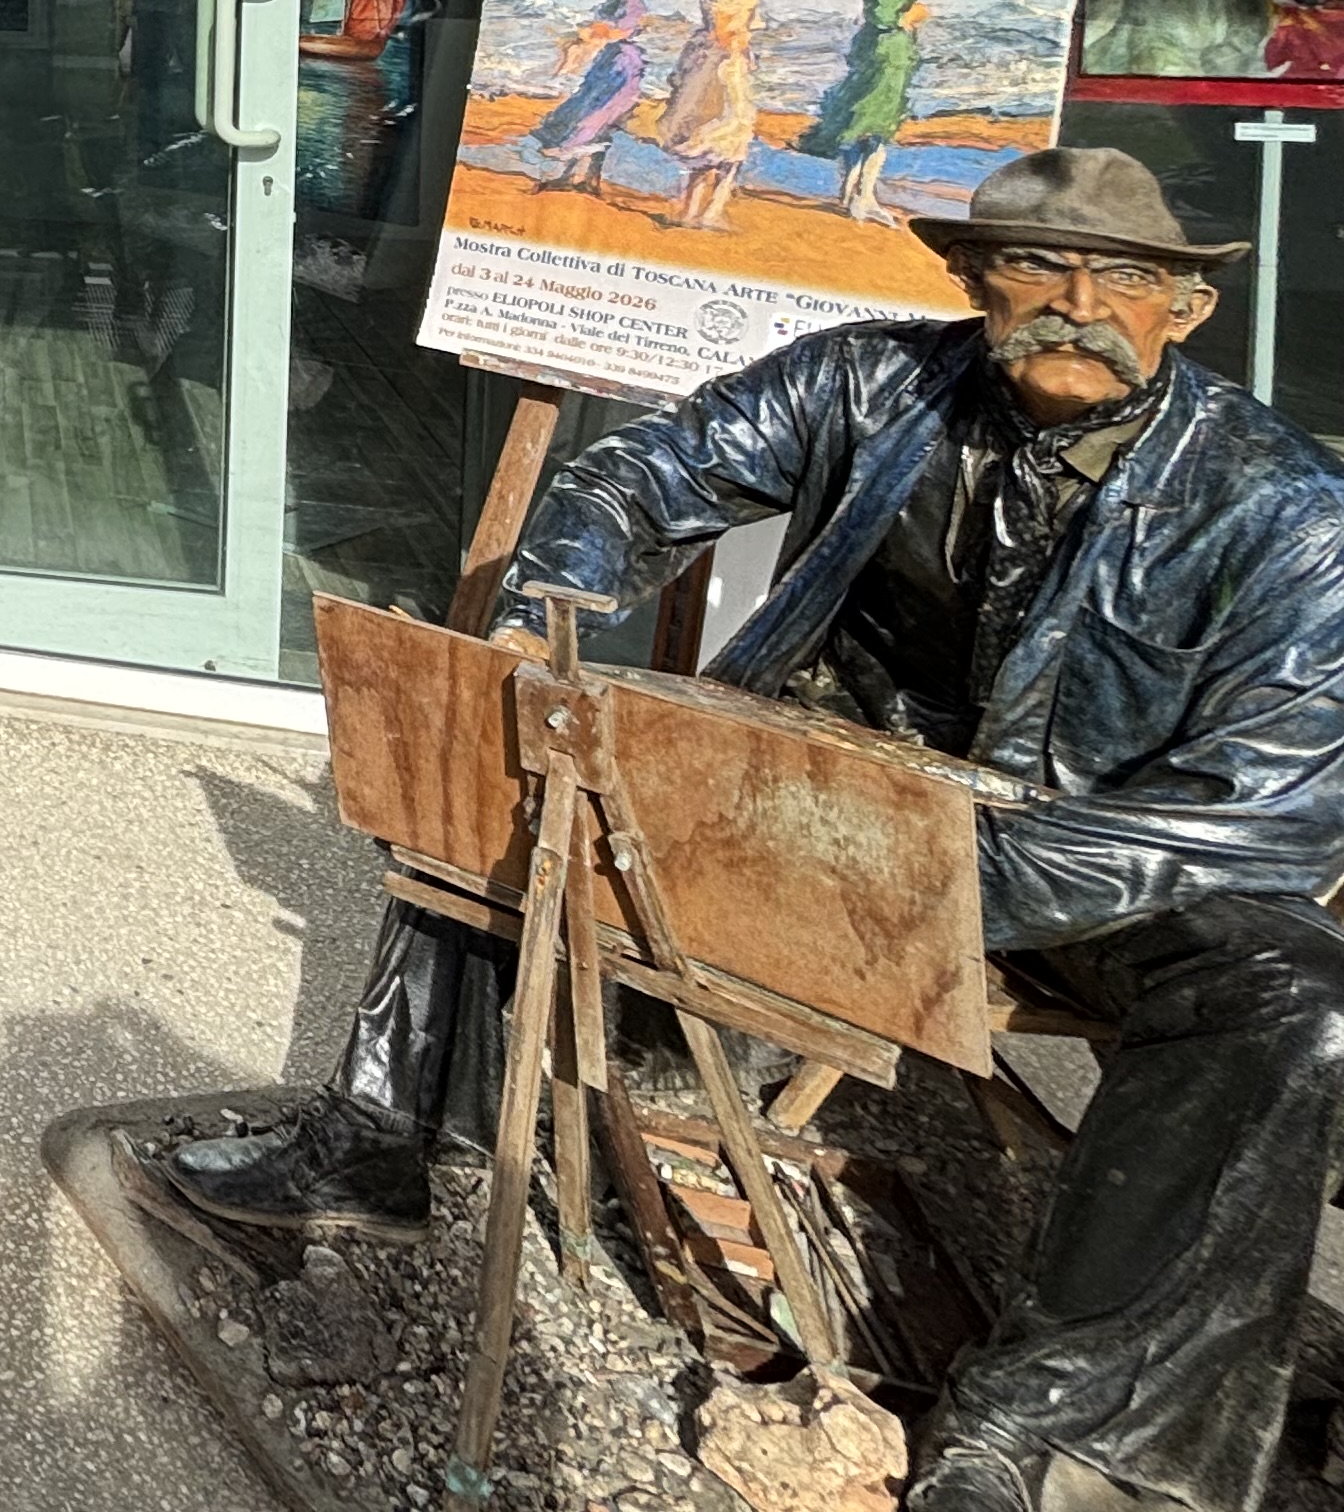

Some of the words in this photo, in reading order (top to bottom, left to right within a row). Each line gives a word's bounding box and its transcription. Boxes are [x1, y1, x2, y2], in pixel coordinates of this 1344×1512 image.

[451, 263, 475, 278] dal
[479, 267, 491, 280] 3
[493, 270, 509, 284] al
[513, 274, 534, 288] 24
[539, 278, 603, 300] Maggio
[607, 291, 657, 311] 2026
[454, 237, 511, 257] Mostra
[517, 247, 601, 273] Collettiva
[607, 262, 625, 276] di
[631, 266, 717, 294] TOSCANA
[724, 284, 779, 304] ARTE
[447, 286, 489, 301] presso
[491, 291, 565, 316] ELIOPOLI
[568, 306, 615, 324] SHOP
[619, 316, 689, 339] CENTER
[497, 308, 557, 329] Madonna
[570, 322, 604, 338] Viale
[608, 330, 630, 344] del
